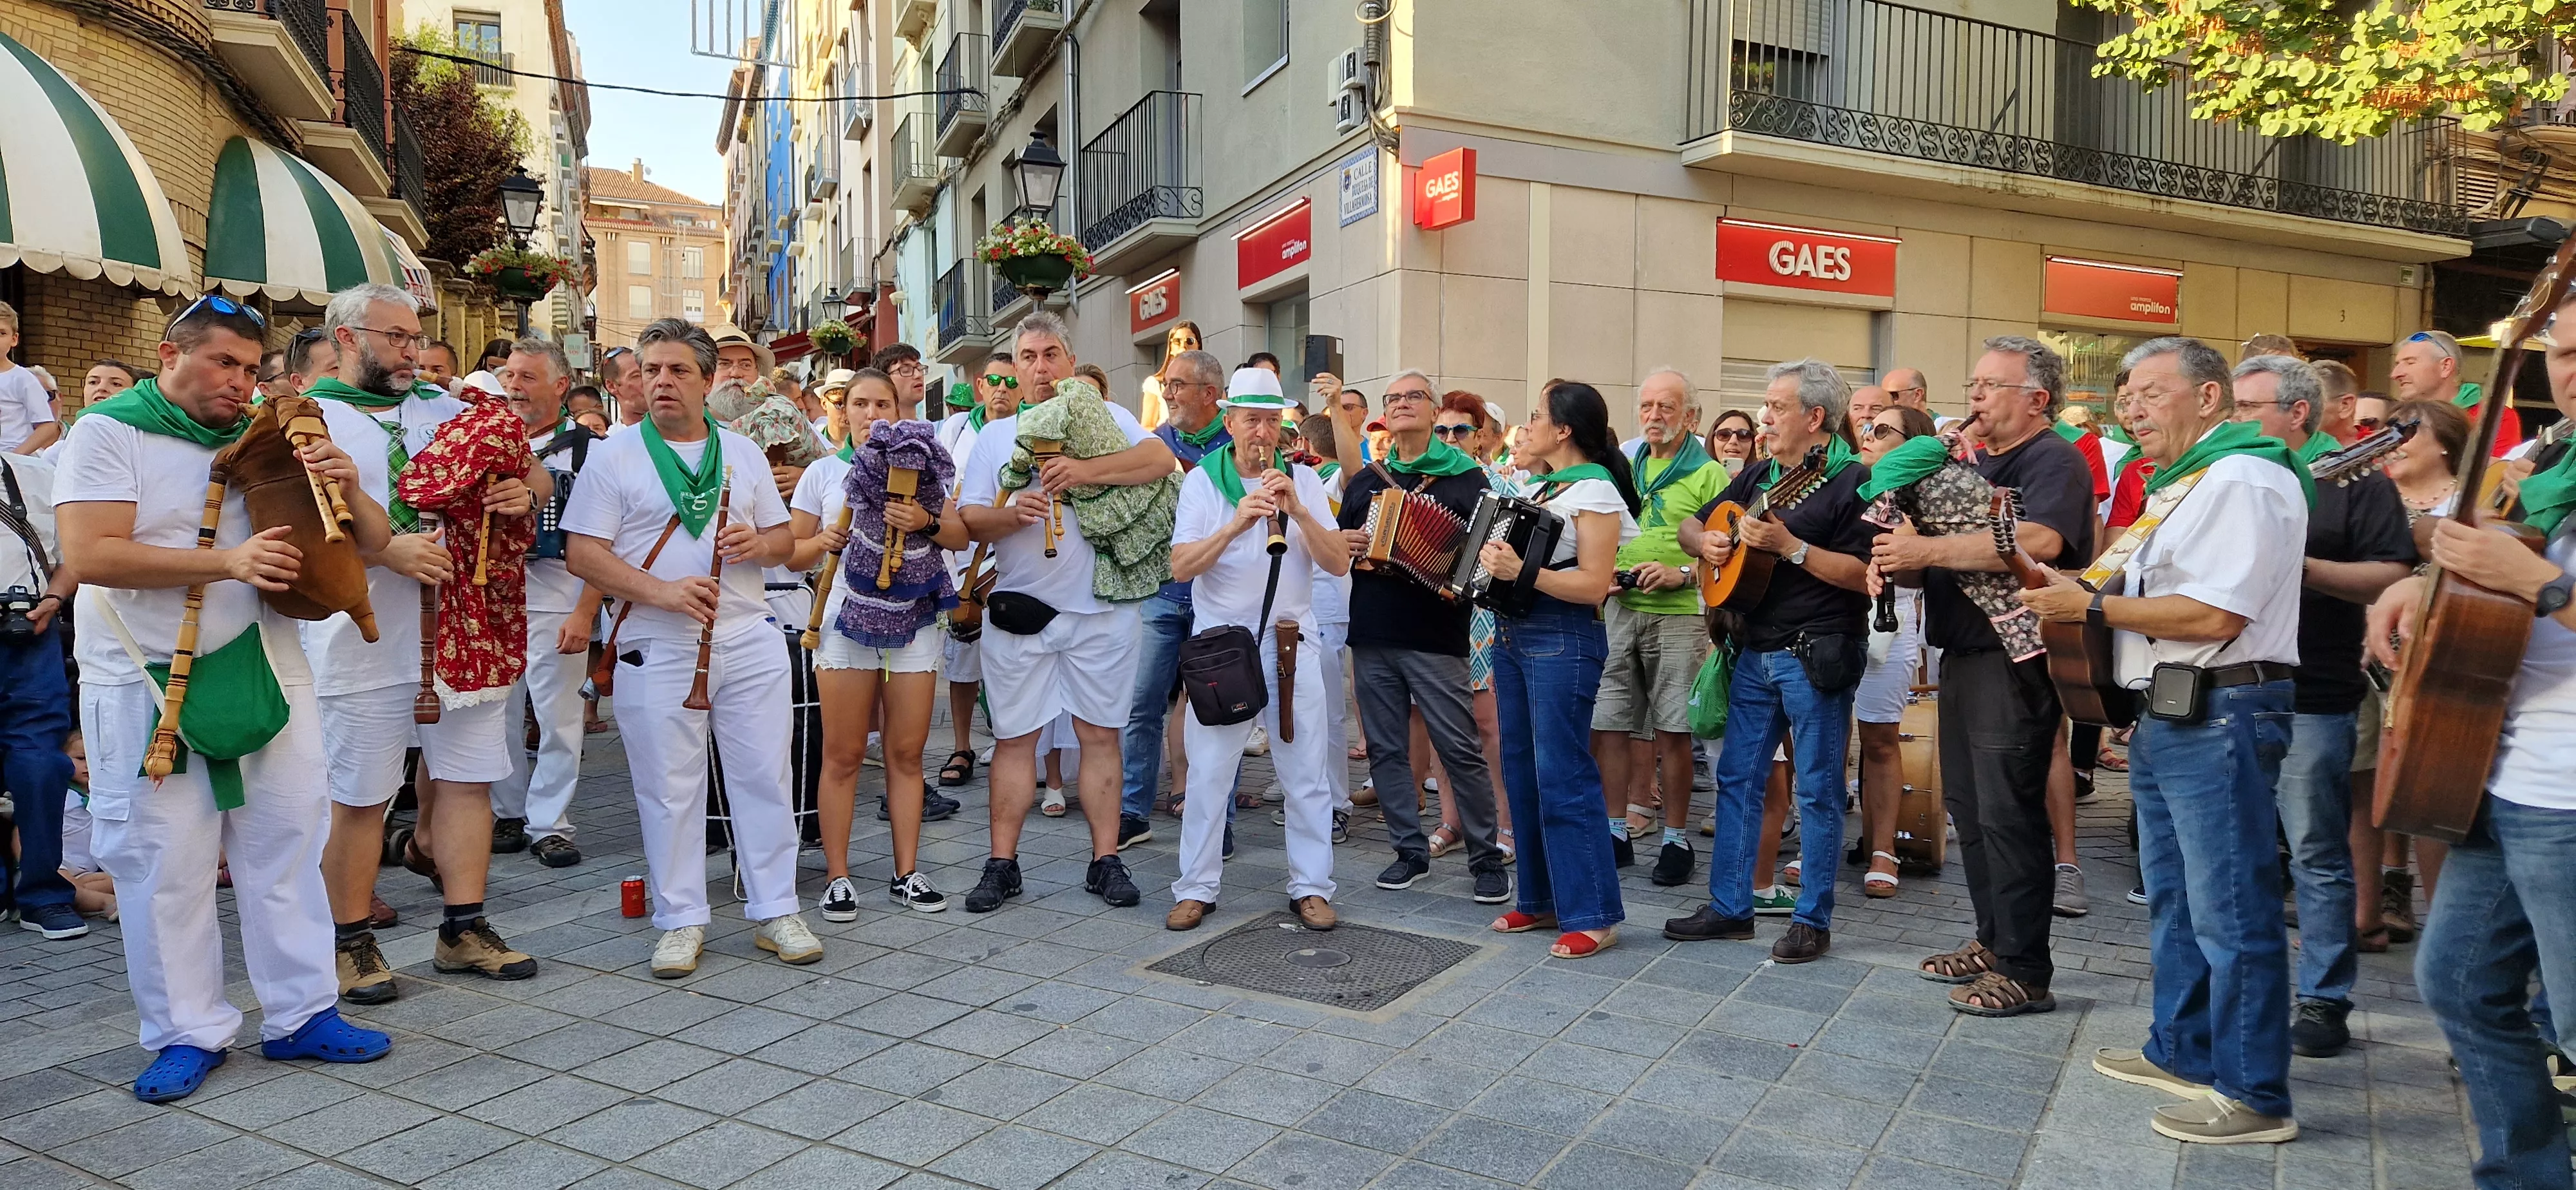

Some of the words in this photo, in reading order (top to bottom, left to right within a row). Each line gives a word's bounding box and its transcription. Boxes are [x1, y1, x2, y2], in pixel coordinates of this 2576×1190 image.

[1354, 161, 1372, 180] CALLE
[1352, 180, 1368, 197] DUQUESA
[1368, 175, 1374, 189] DE
[1425, 171, 1459, 198] GAES
[1343, 193, 1372, 215] VILLAHERMOSA
[1282, 240, 1307, 260] amplifon
[1768, 240, 1852, 281] GAES
[1139, 286, 1168, 321] GAES
[2130, 301, 2171, 316] amplifon
[2340, 310, 2345, 323] 3
